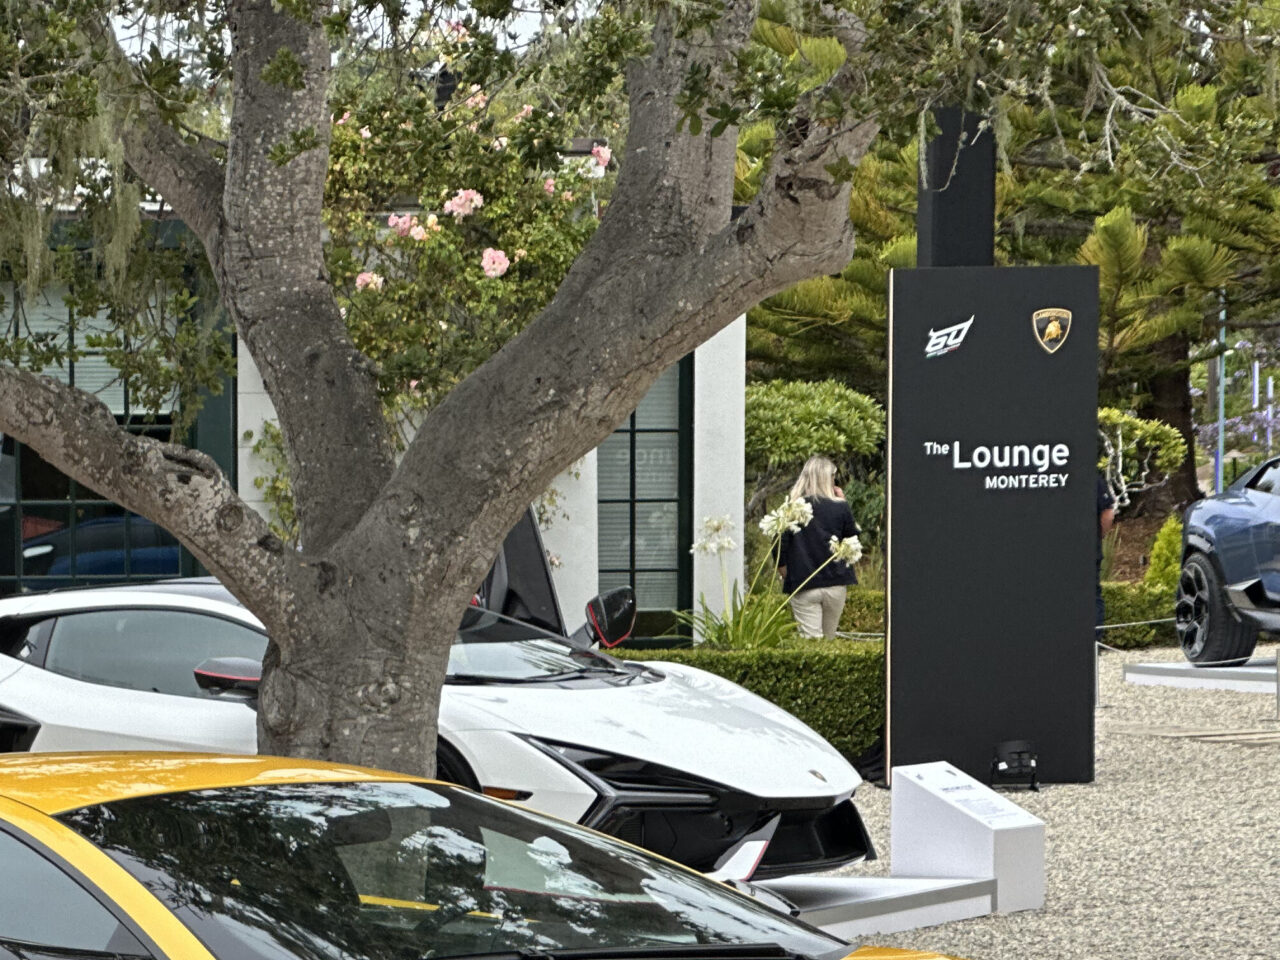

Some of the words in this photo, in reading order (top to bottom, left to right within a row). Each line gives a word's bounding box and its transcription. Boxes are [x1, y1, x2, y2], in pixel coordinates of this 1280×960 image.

[923, 441, 950, 455] The
[953, 440, 1070, 473] Lounge
[985, 473, 1069, 489] MONTEREY
